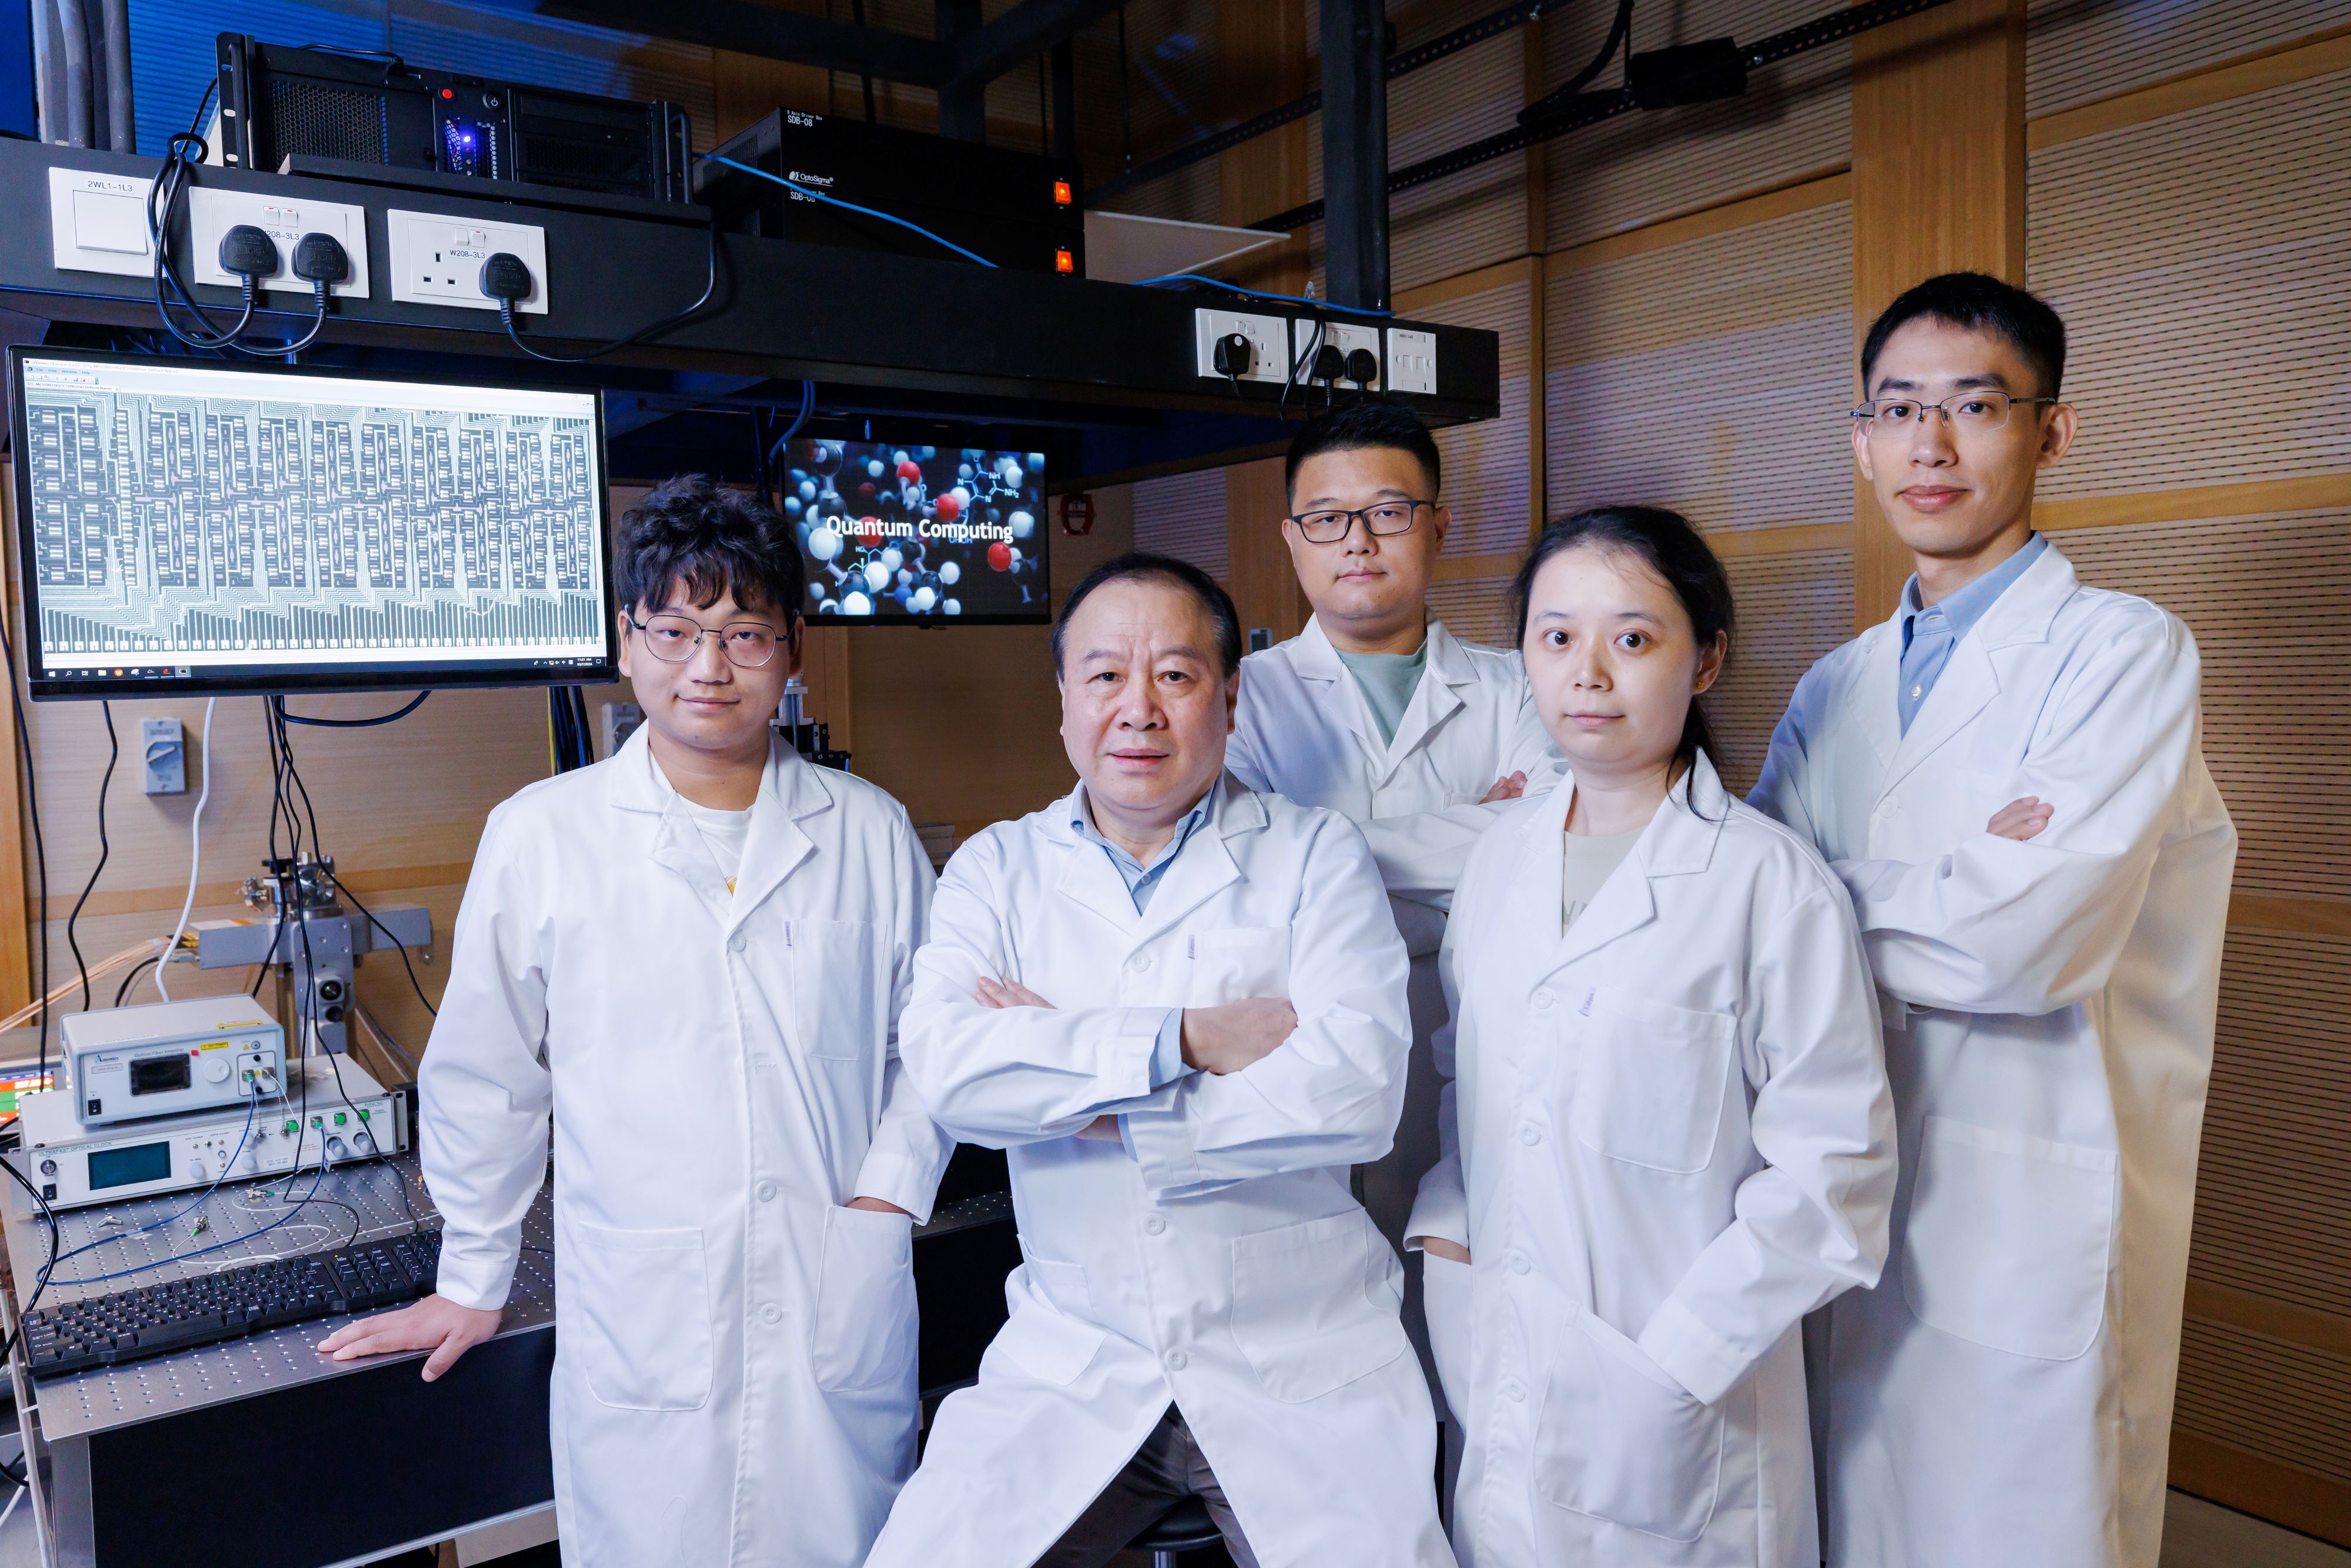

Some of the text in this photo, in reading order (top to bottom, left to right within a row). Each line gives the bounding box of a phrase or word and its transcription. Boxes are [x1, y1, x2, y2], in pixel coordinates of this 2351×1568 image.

[788, 115, 813, 127] SDB-08
[88, 180, 133, 192] 2WL1-1L3
[449, 249, 485, 259] W208-3L3
[826, 515, 1013, 544] Quantum Computing
[38, 1148, 70, 1156] ULTRAFAST
